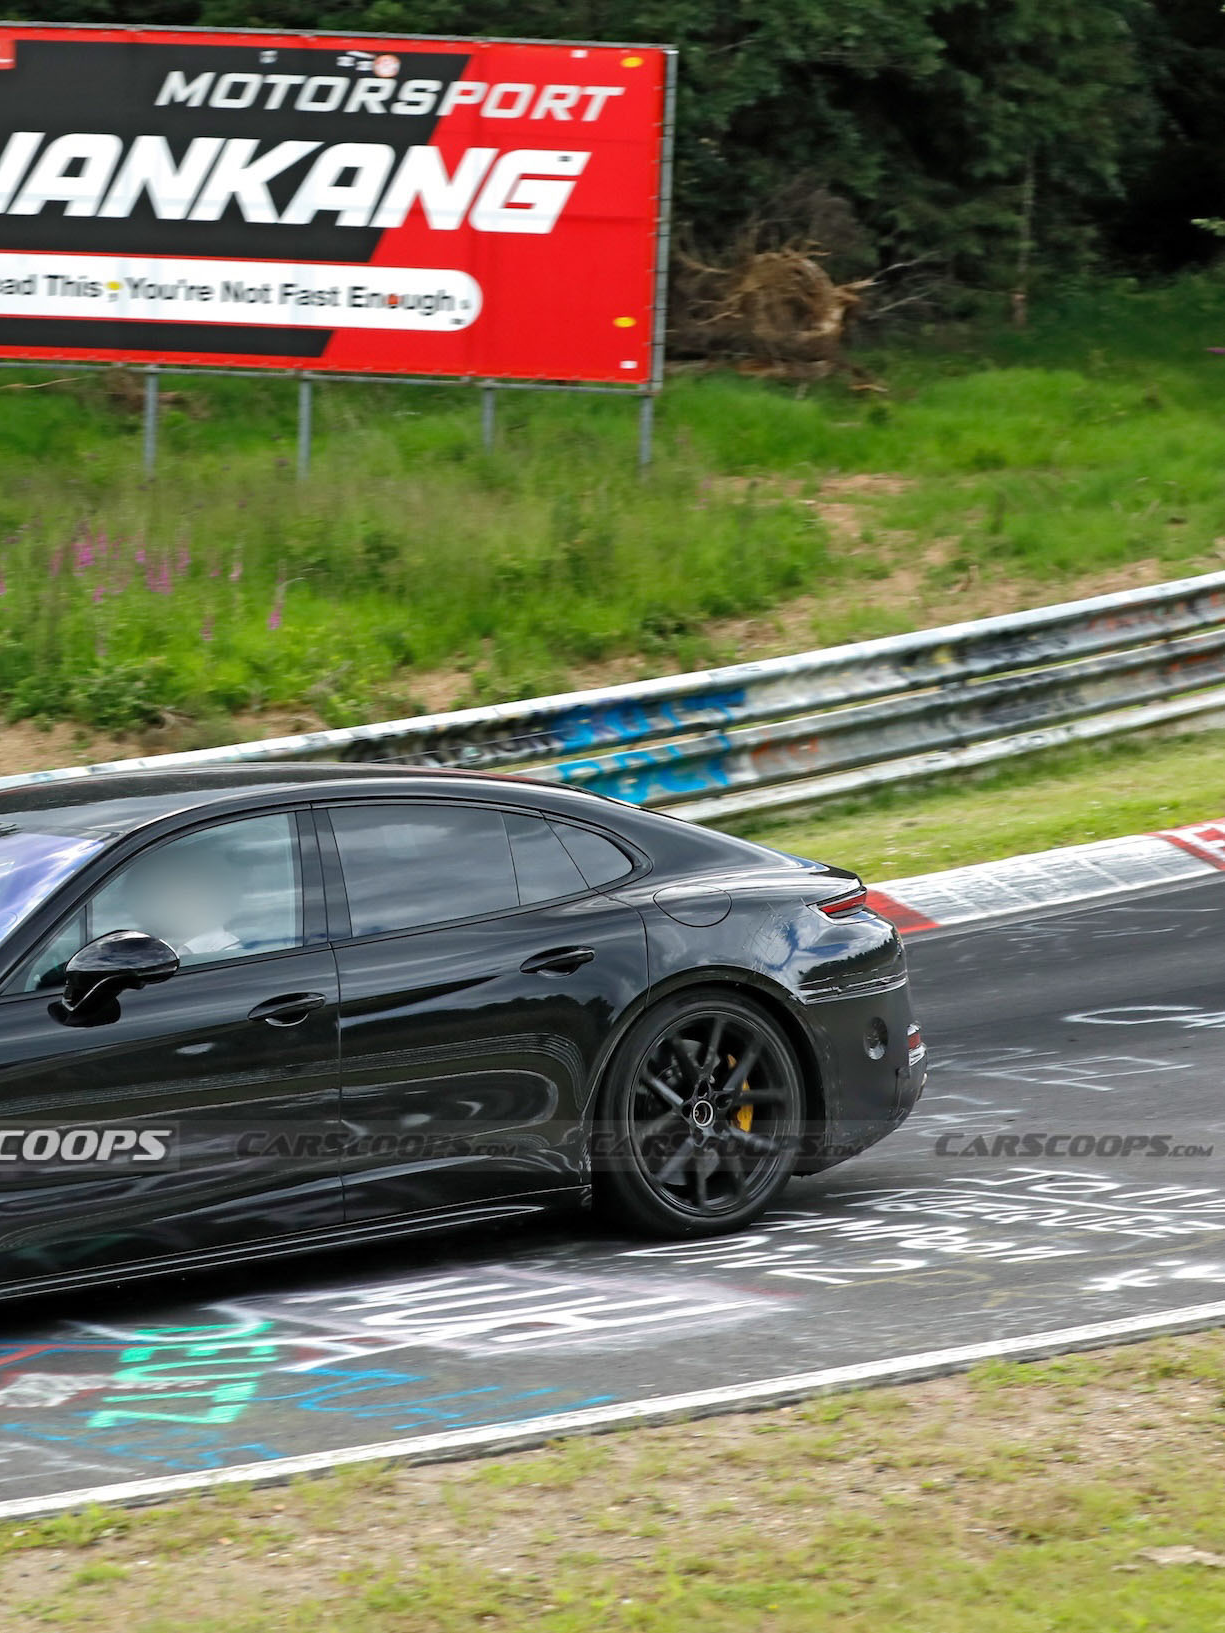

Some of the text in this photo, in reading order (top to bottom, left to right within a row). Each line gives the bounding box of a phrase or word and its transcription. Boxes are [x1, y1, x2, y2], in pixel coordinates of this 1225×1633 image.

[155, 71, 624, 122] MOTORSPORT
[124, 276, 214, 302] You're
[220, 280, 271, 304] Not
[279, 283, 342, 308] Fast
